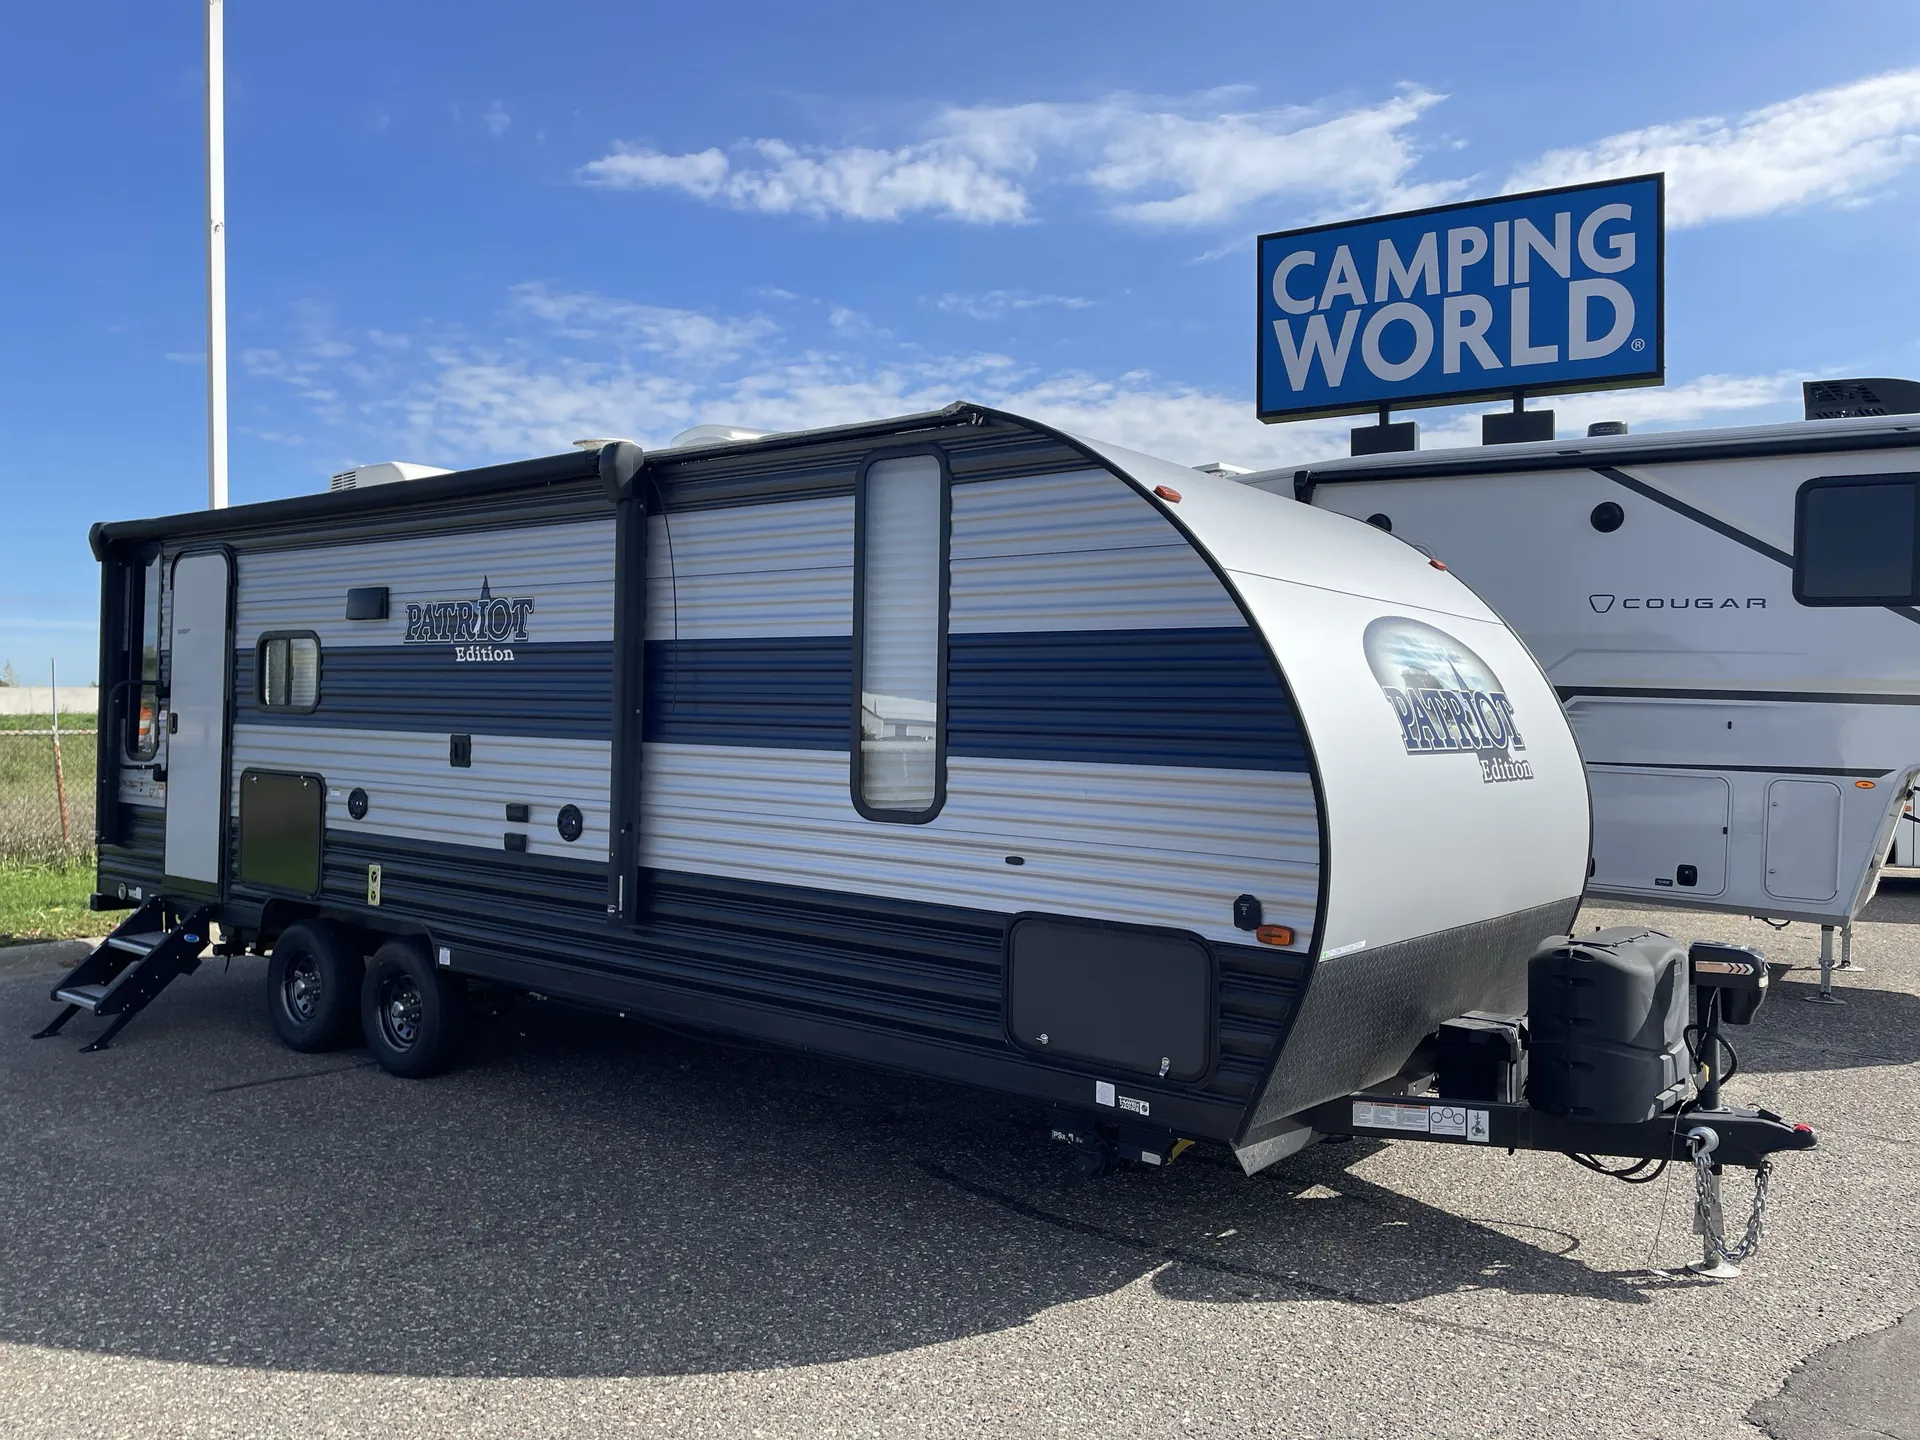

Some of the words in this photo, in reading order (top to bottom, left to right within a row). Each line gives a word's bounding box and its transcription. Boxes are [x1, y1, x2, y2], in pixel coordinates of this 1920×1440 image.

[1272, 203, 1636, 315] CAMPING
[404, 597, 535, 643] PATRIOT
[1622, 598, 1767, 609] COUGAR
[455, 645, 515, 662] Edition
[1383, 686, 1526, 754] PATRIOT
[1480, 757, 1534, 782] Edition
